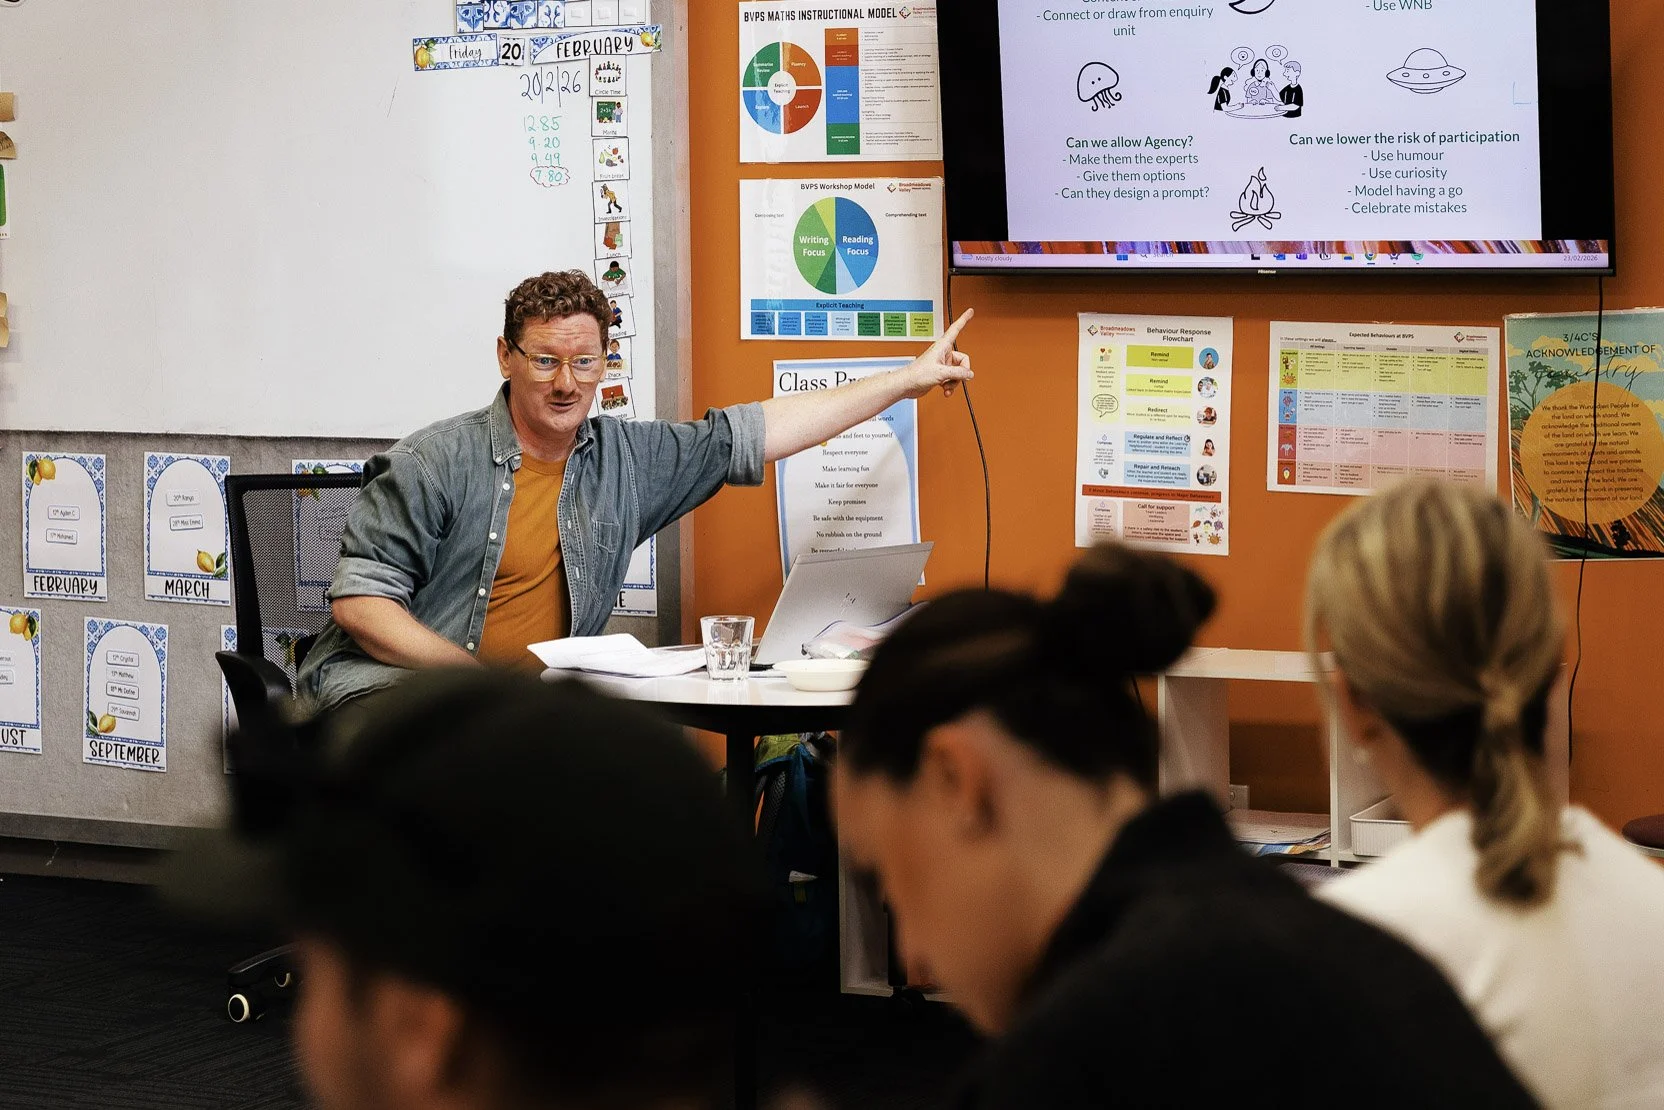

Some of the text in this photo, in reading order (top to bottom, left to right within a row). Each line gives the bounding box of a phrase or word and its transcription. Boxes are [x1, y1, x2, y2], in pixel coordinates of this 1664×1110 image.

[1373, 0, 1432, 10] Use WNB
[744, 8, 897, 22] BVPS MATHS INSTRUCTIONAL MODEL
[1043, 6, 1213, 20] Connect or draw from enquiry
[1114, 26, 1136, 36] unit
[449, 37, 633, 63] Friday 20 FEBRUARY
[1066, 136, 1193, 150] Can we allow Agency?
[1289, 134, 1312, 144] Can
[1337, 133, 1371, 144] lower
[1374, 133, 1394, 143] the
[1398, 132, 1420, 143] risk
[1423, 132, 1435, 143] of
[1439, 131, 1519, 144] participation
[1070, 153, 1198, 167] Make them the experts
[1371, 150, 1444, 161] Use humour
[1083, 170, 1185, 184] Give them options
[1369, 167, 1447, 180] Use curiosity
[1062, 188, 1084, 198] Can
[1086, 188, 1111, 201] they
[1114, 186, 1150, 201] design
[1162, 186, 1209, 200] prompt?
[1355, 185, 1393, 196] Model
[1396, 185, 1435, 198] having
[1448, 188, 1462, 198] go
[1352, 202, 1466, 213] Celebrate mistakes
[799, 236, 829, 246] Writing
[843, 236, 873, 245] Reading
[1526, 345, 1655, 358] ACKNOWLEDGEMENT OF
[779, 372, 827, 392] Class
[34, 576, 98, 594] FEBRUARY
[165, 580, 210, 598] MARCH
[90, 740, 160, 764] SEPTEMBER
